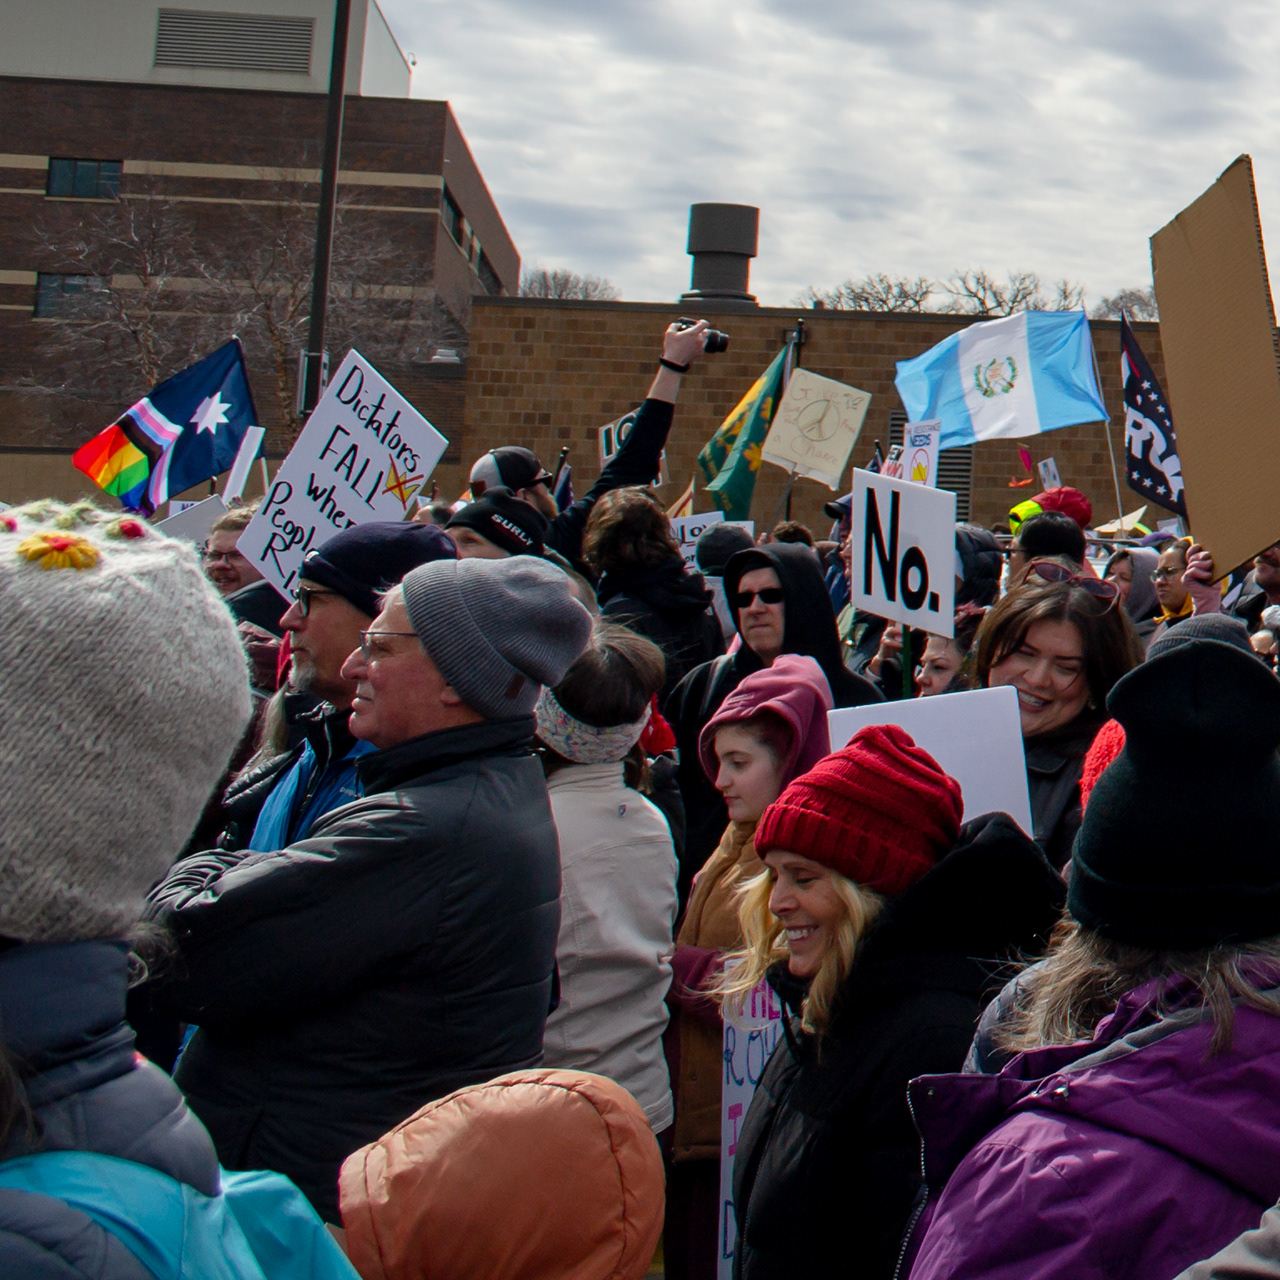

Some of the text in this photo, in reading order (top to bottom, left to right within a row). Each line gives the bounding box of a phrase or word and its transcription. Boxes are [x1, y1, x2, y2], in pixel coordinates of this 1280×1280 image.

[318, 424, 385, 511] FALL
[335, 365, 421, 473] Dictators
[262, 481, 321, 554] Peopl
[865, 487, 940, 614] No.
